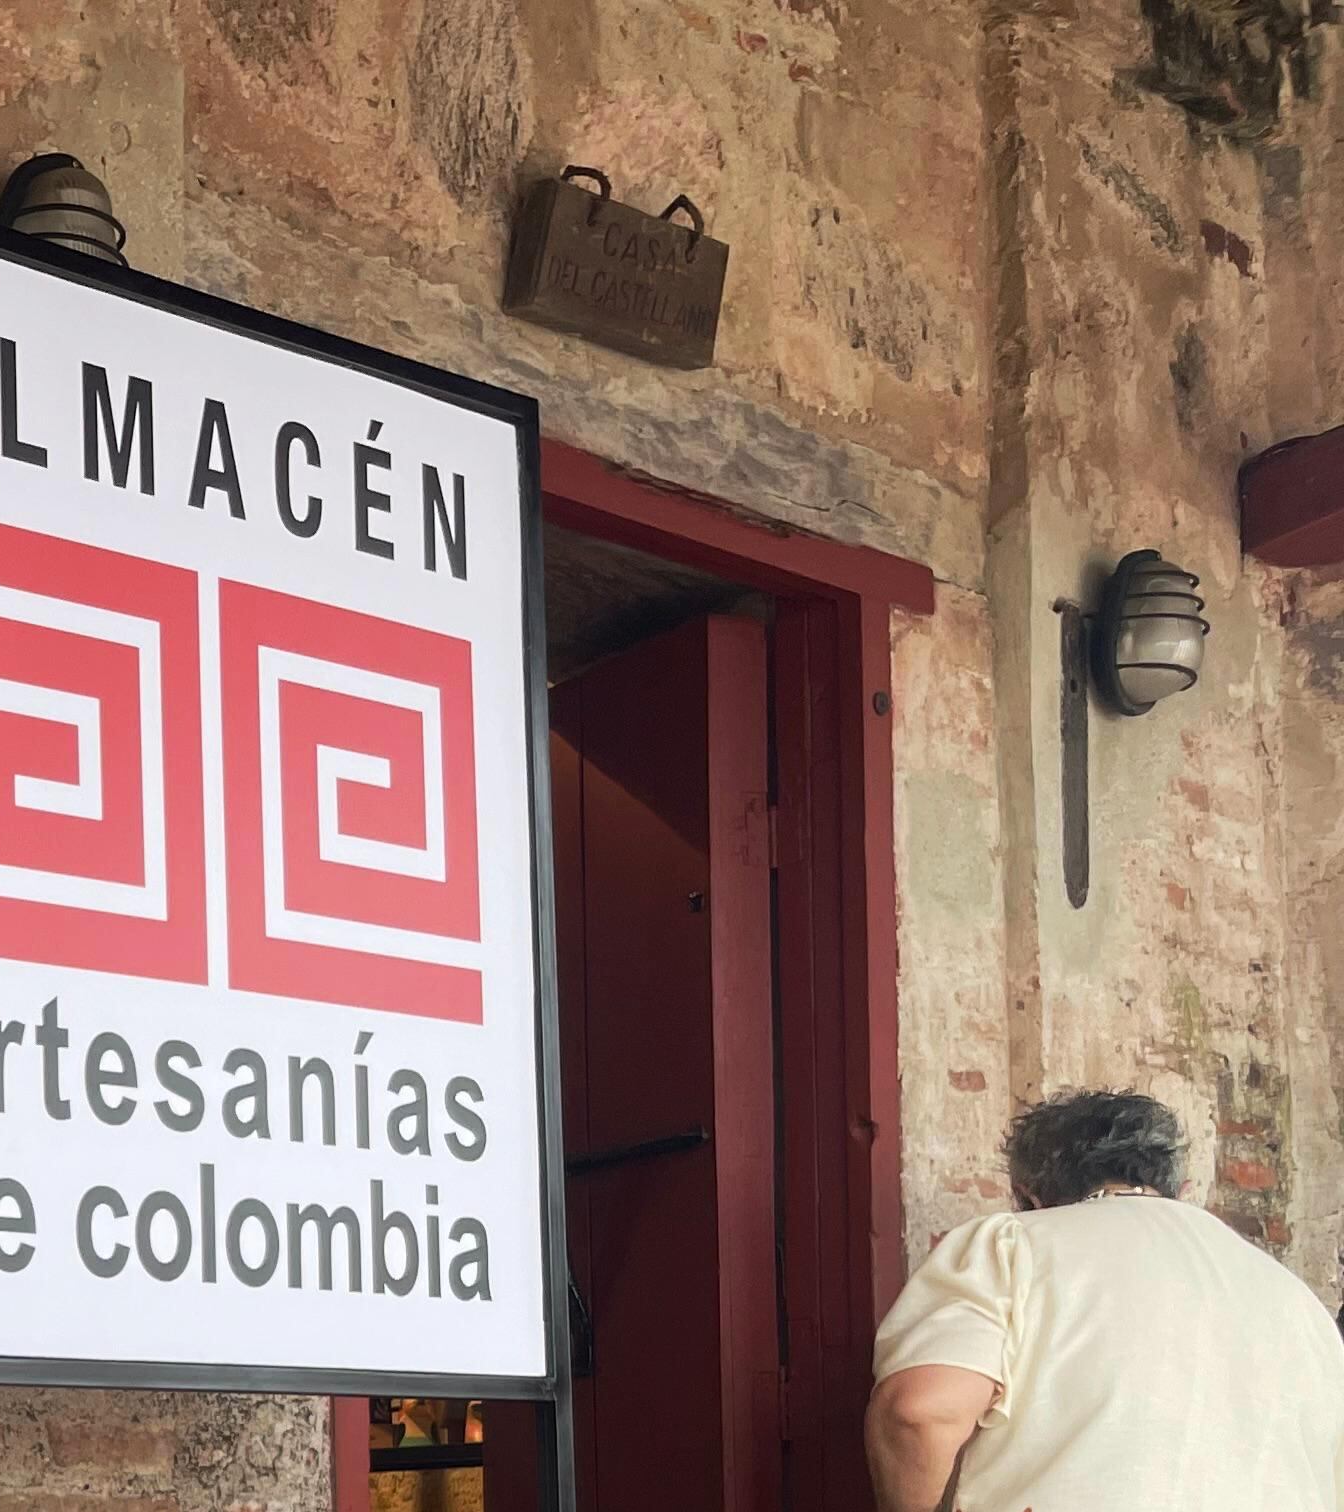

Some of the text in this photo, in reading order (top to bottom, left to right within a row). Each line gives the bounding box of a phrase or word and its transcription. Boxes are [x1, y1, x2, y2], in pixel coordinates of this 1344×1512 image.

[547, 255, 582, 297] DEL
[603, 221, 677, 281] CASA
[76, 1163, 494, 1302] colombia
